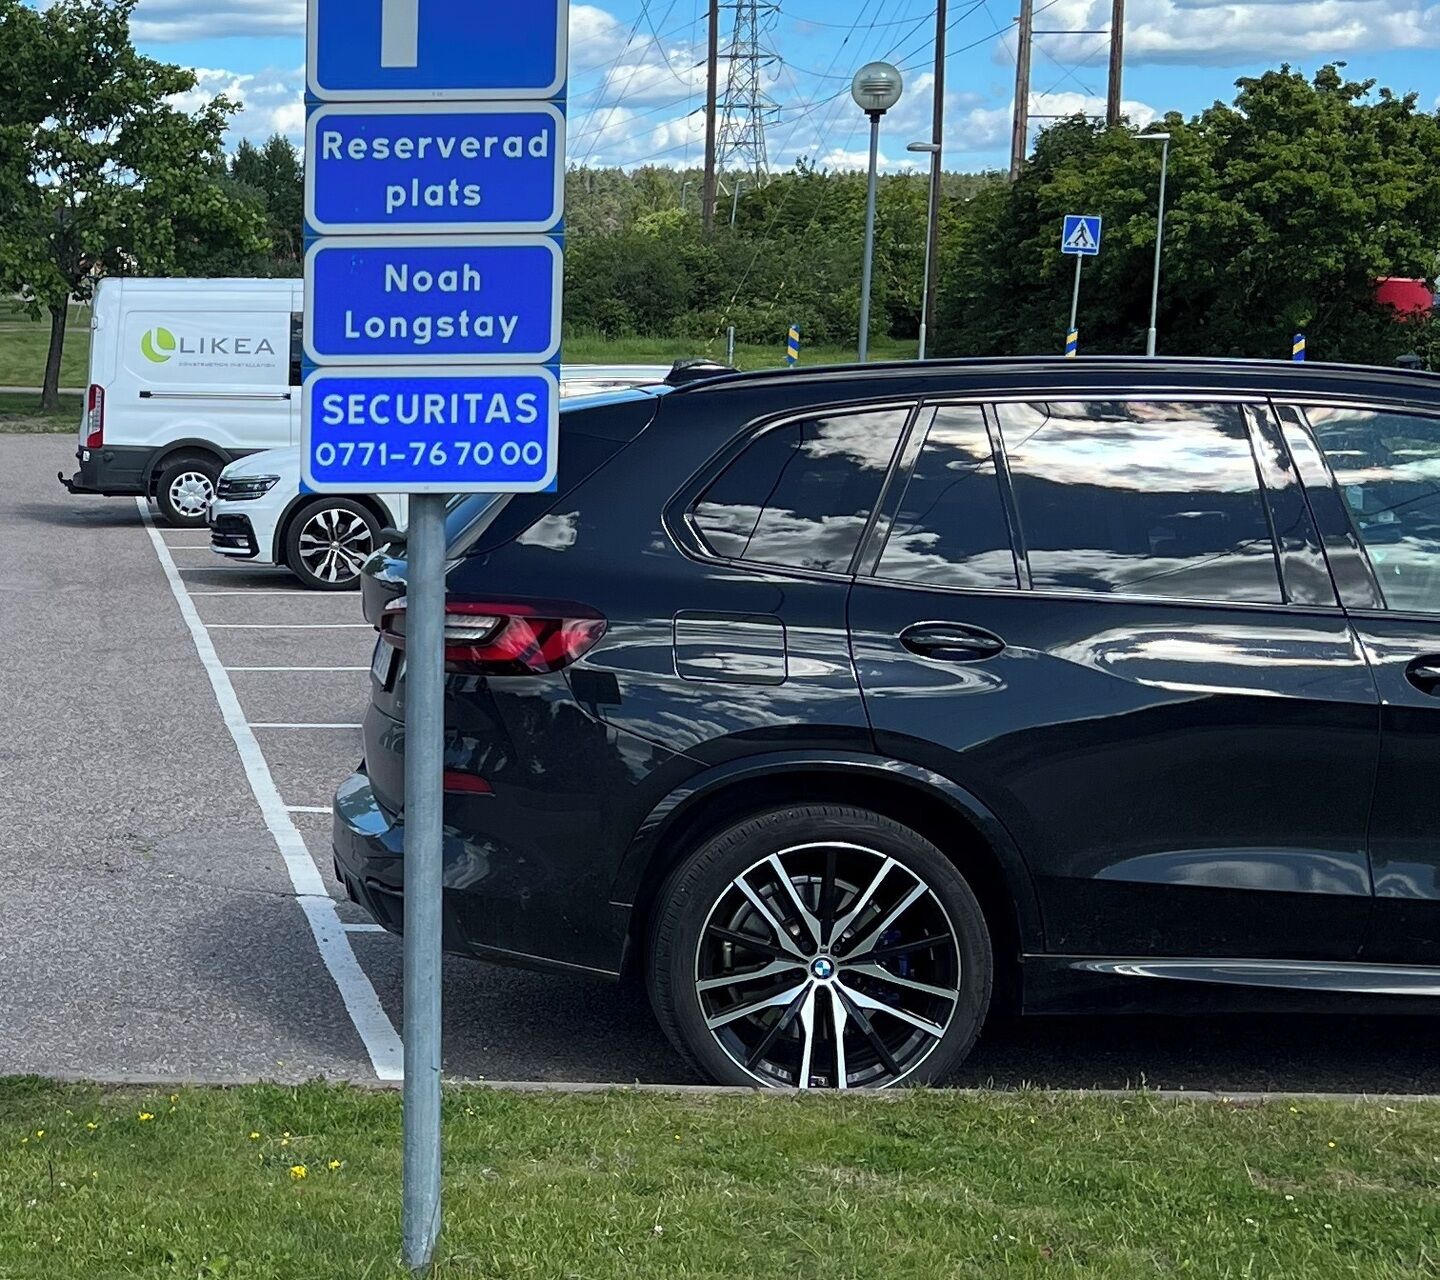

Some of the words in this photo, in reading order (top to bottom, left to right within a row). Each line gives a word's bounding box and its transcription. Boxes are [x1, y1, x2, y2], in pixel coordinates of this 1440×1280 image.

[322, 129, 548, 160] Reserverad
[386, 178, 481, 214] plats
[385, 263, 481, 292] Noah
[345, 310, 518, 345] Longstay
[180, 337, 275, 355] LIKEA
[322, 393, 538, 424] SECURITAS
